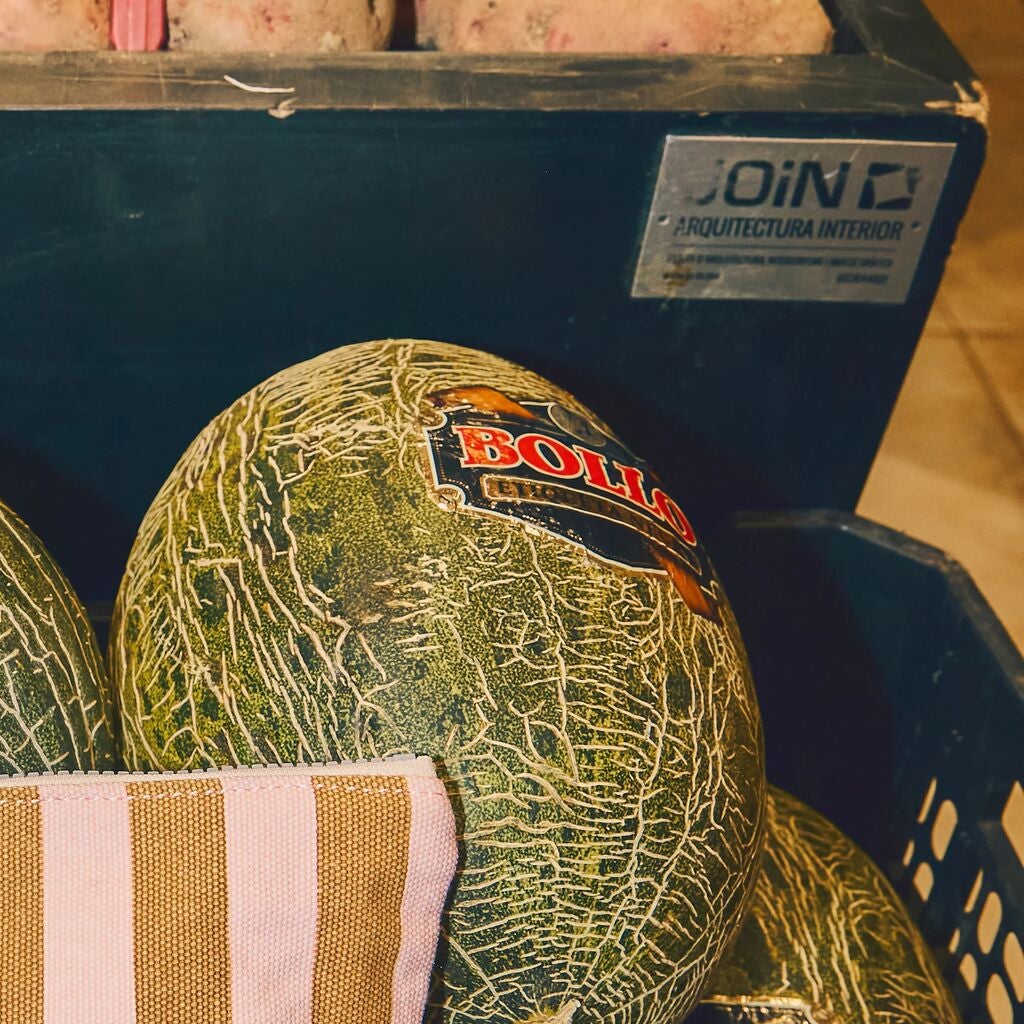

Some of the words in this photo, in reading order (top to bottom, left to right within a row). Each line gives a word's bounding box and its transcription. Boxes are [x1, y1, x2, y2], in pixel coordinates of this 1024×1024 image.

[673, 215, 813, 239] ARQUITECTURA
[817, 219, 904, 241] INTERIOR
[451, 425, 697, 547] BOLLO
